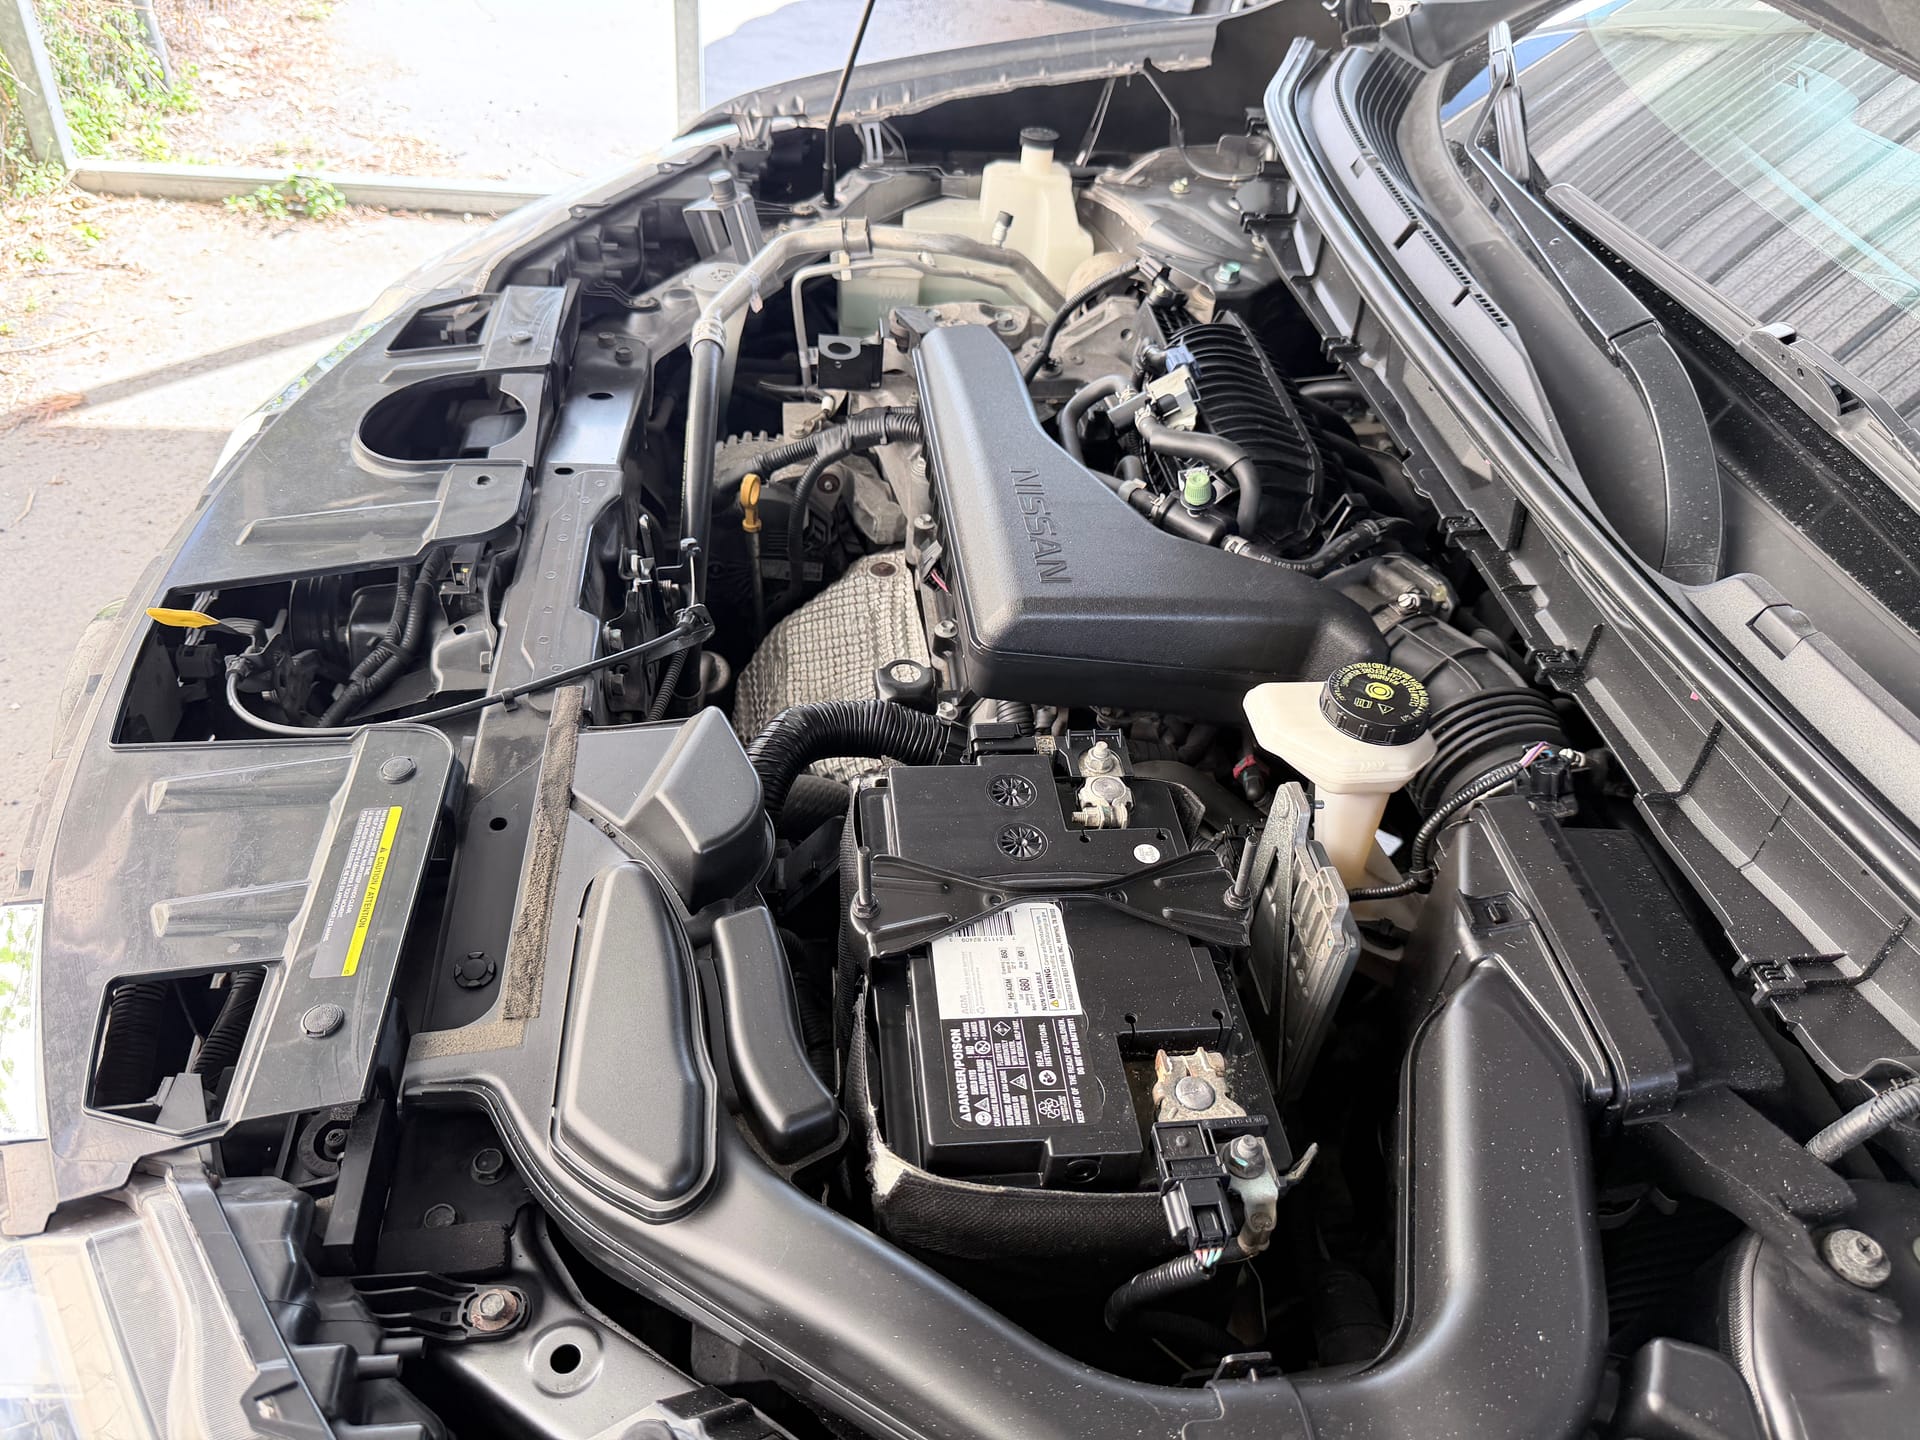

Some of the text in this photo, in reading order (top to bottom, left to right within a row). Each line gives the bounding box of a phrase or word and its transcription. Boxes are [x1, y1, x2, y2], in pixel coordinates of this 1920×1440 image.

[1009, 466, 1072, 583] NISSAN
[369, 856, 384, 884] CAUTION
[357, 891, 375, 927] ATTENTION
[1004, 978, 1014, 999] H5-AGM
[1018, 978, 1030, 991] 680
[1035, 972, 1045, 997] SPILLABLE
[1043, 966, 1055, 999] WARNING:
[959, 994, 968, 1014] AGM
[1064, 983, 1075, 1010] DISTRIBUTED
[964, 1045, 975, 1054] NO
[1037, 1022, 1052, 1066] INSTRUCTIONS.
[1066, 1017, 1085, 1074] DO NOT OPEN BATTERY!
[1034, 1050, 1044, 1066] READ
[949, 1028, 970, 1112] DANGER/POISON
[998, 1070, 1007, 1083] CAUSE
[1057, 1017, 1085, 1123] KEEP OUT OF THE REACH OF CHILDREN.
[977, 1072, 988, 1094] EXPLOSIVE
[987, 1080, 998, 1103] BLINDNESS
[1000, 1083, 1009, 1092] CAN
[1001, 1092, 1011, 1103] ACID
[991, 1103, 1000, 1117] CAUSE
[1012, 1102, 1022, 1125] BLINDNESS
[1021, 1109, 1030, 1125] SEVERE
[993, 1117, 1001, 1126] CAN
